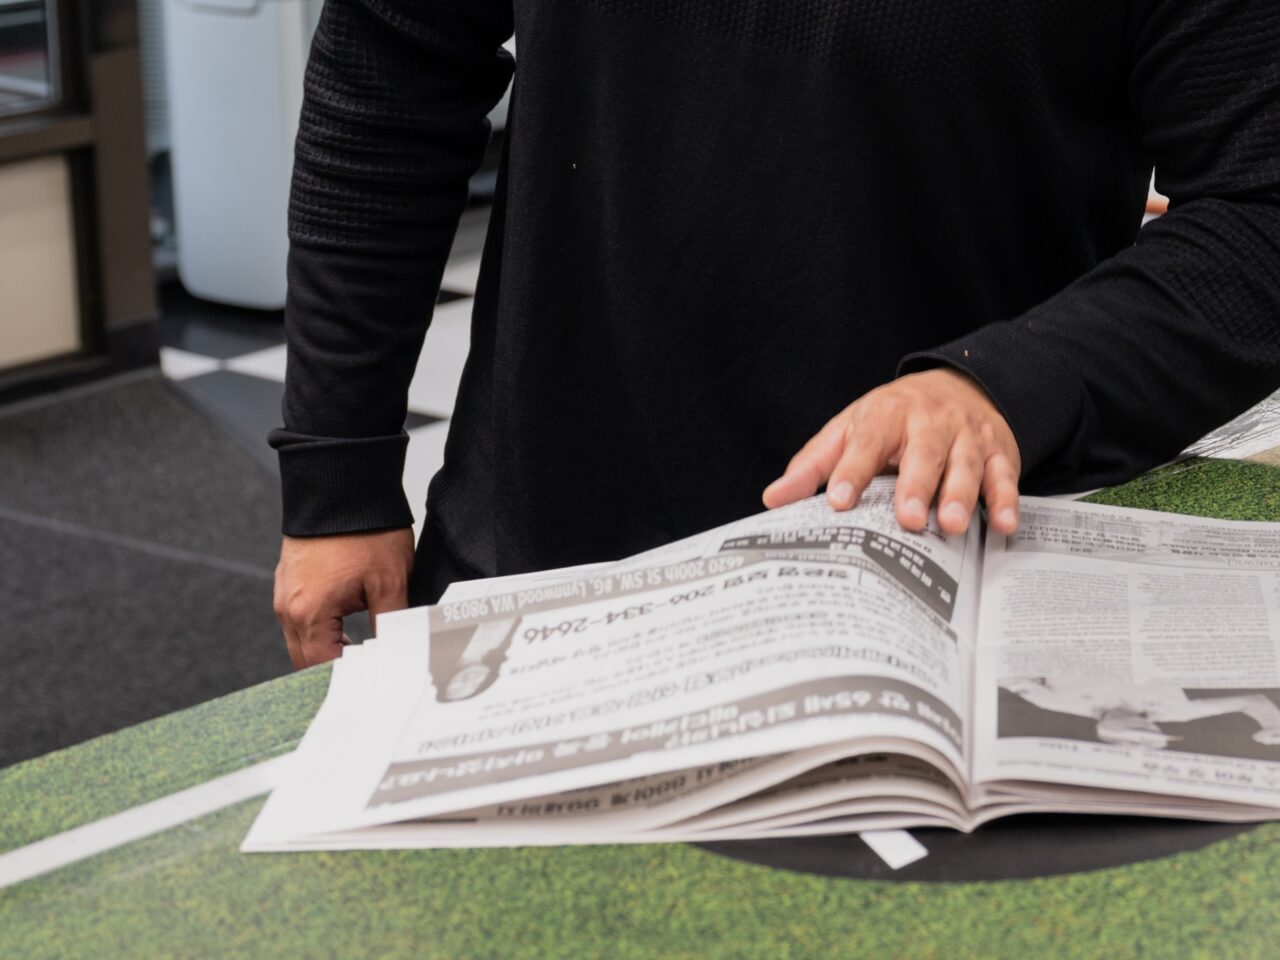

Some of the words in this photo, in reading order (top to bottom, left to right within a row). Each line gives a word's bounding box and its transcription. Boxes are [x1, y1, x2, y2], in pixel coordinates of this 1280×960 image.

[663, 560, 706, 587] 200th
[708, 553, 746, 575] 4620
[645, 568, 662, 588] St
[490, 594, 516, 613] WA
[517, 580, 586, 610] Lynnwood
[442, 598, 489, 625] 98036
[522, 583, 716, 646] 206-334-2646
